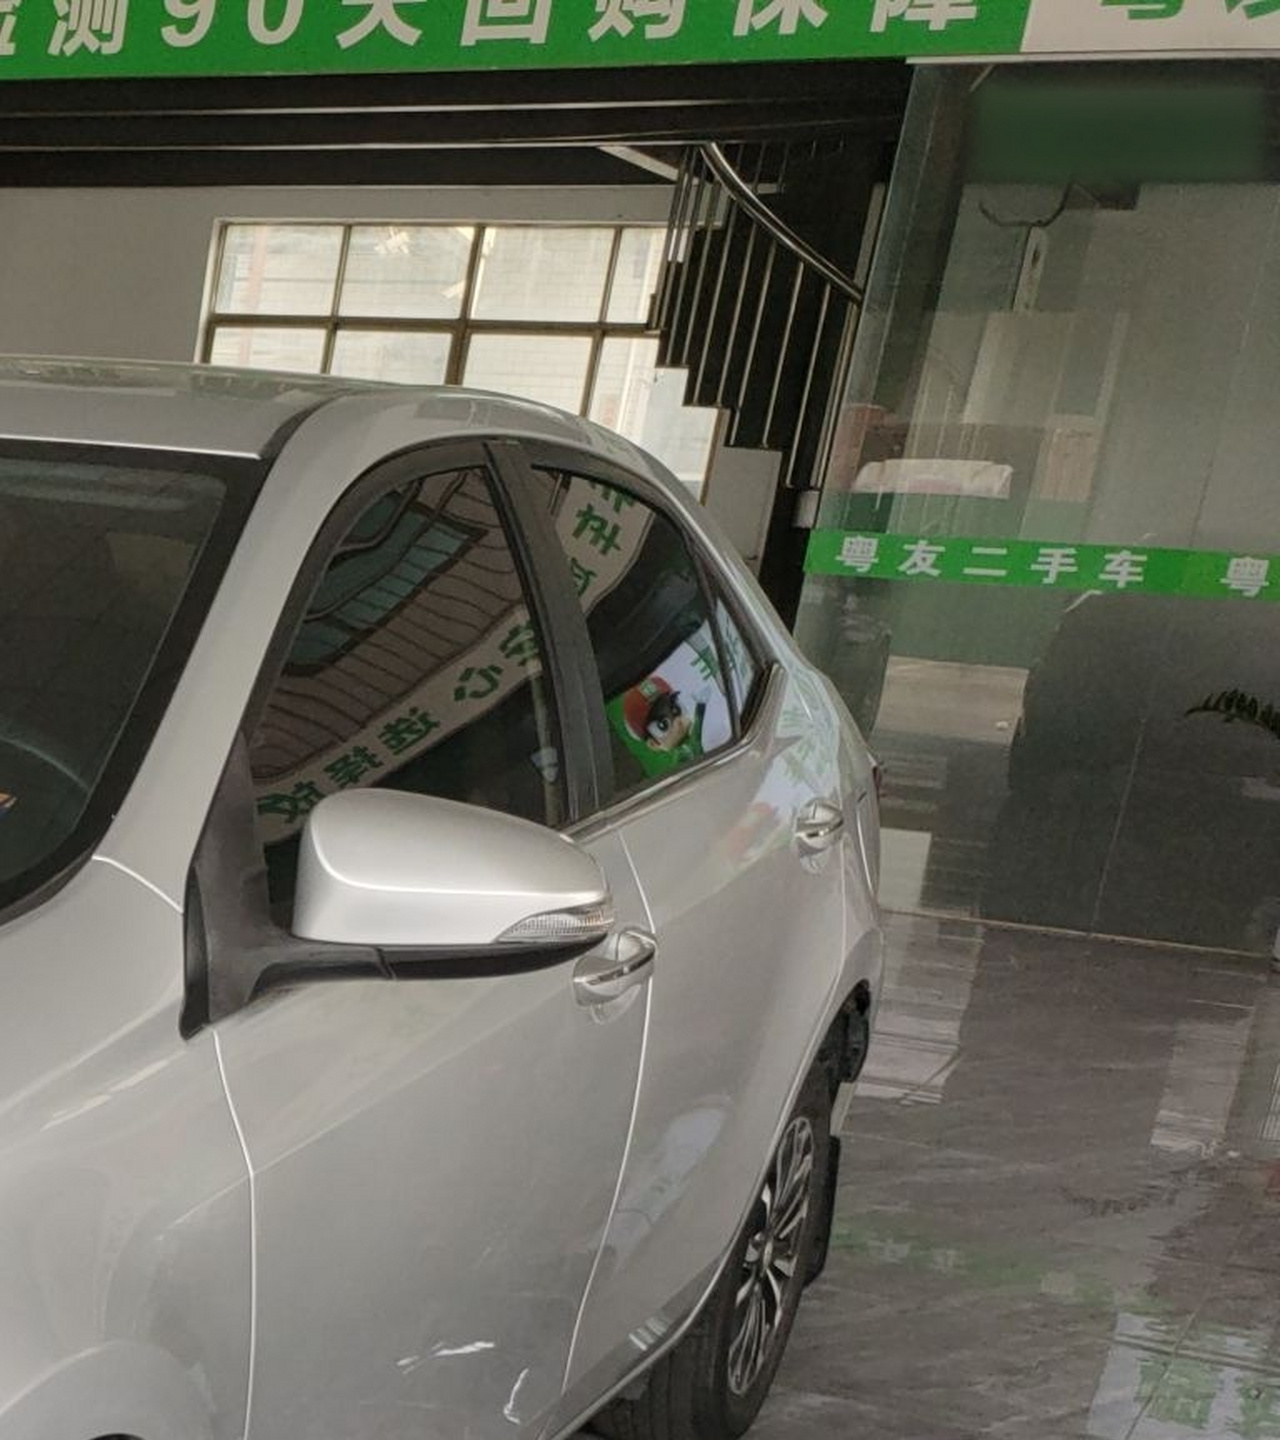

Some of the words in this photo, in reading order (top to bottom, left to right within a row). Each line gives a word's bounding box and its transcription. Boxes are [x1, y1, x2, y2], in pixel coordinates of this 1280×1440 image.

[835, 535, 1148, 589] 粤友二手车
